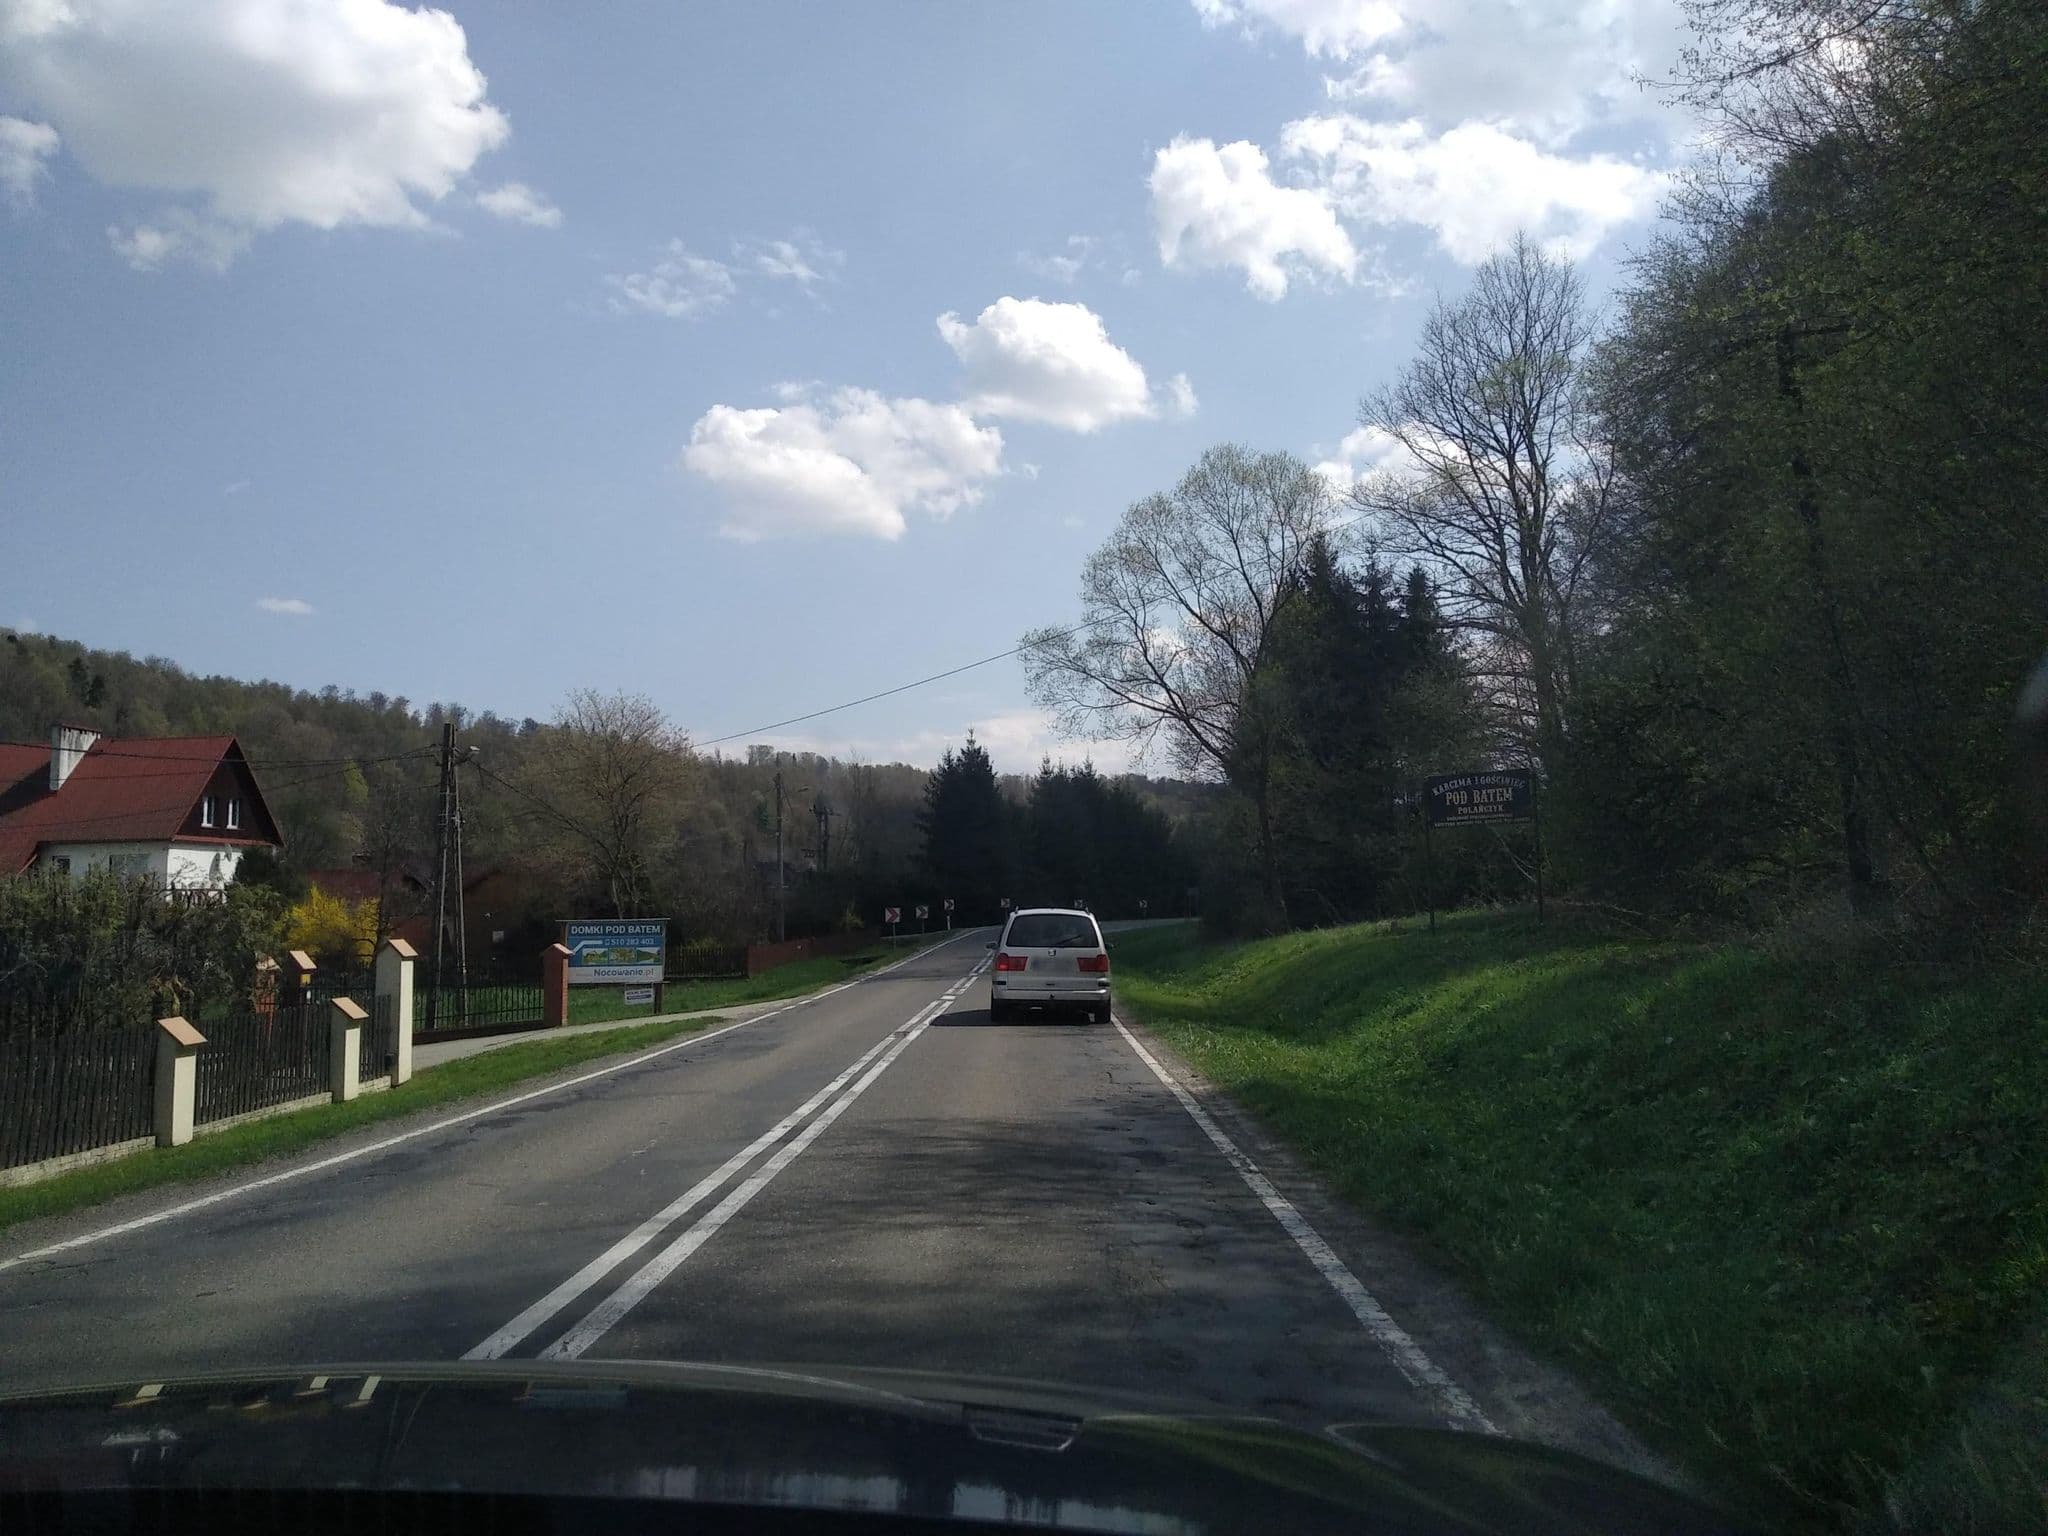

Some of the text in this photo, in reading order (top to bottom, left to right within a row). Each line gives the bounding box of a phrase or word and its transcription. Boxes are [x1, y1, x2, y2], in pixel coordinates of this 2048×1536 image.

[1431, 777, 1472, 796] KARCZMA
[1446, 787, 1513, 805] POD BATEM
[1457, 805, 1504, 815] POLAŃCZYK
[571, 925, 661, 934] DOMKI POD BATEM
[593, 968, 654, 978] Nocowanie.pl
